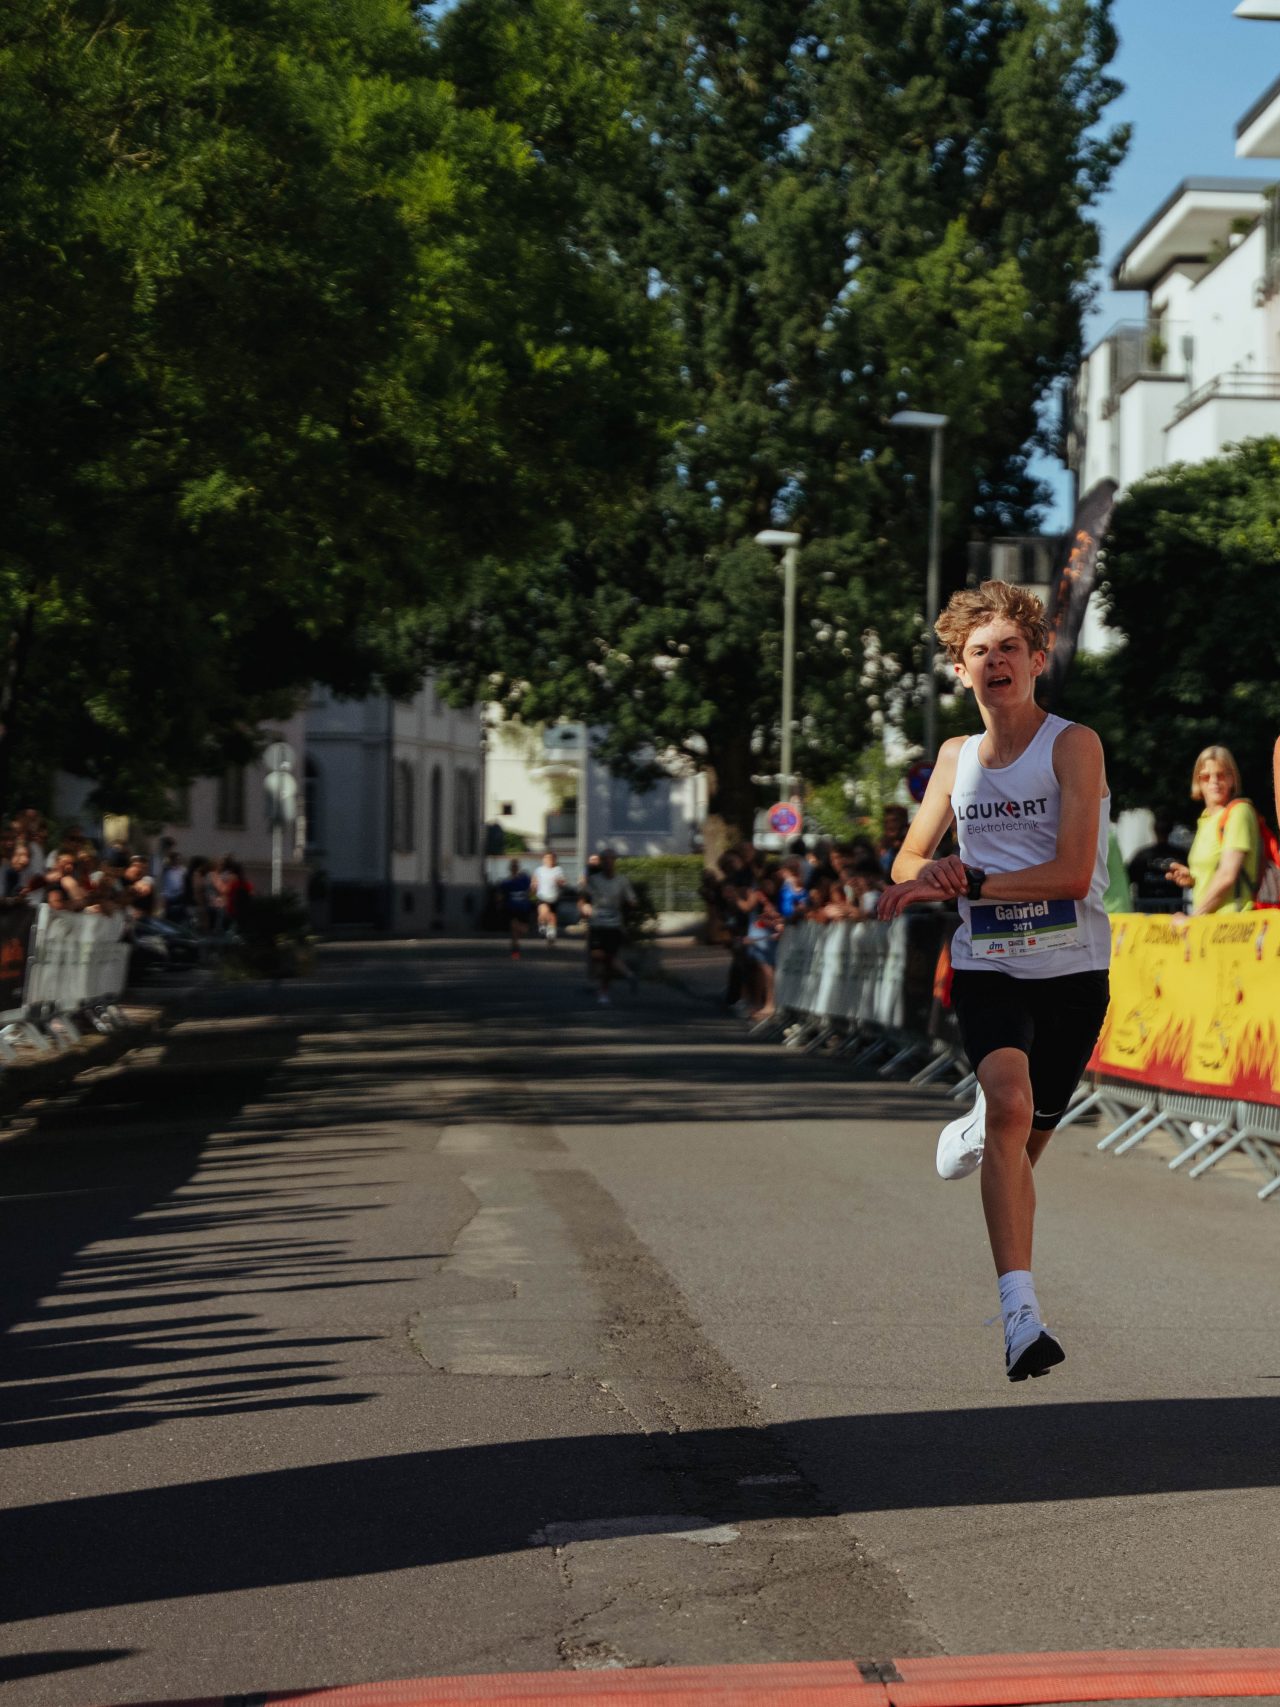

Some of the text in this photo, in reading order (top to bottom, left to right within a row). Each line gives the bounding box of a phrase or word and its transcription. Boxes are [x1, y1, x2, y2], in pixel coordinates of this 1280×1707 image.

[967, 820, 1040, 835] Elektrotechnik
[994, 900, 1049, 920] Gabriel
[1013, 922, 1033, 932] 3471
[989, 942, 1003, 950] dm
